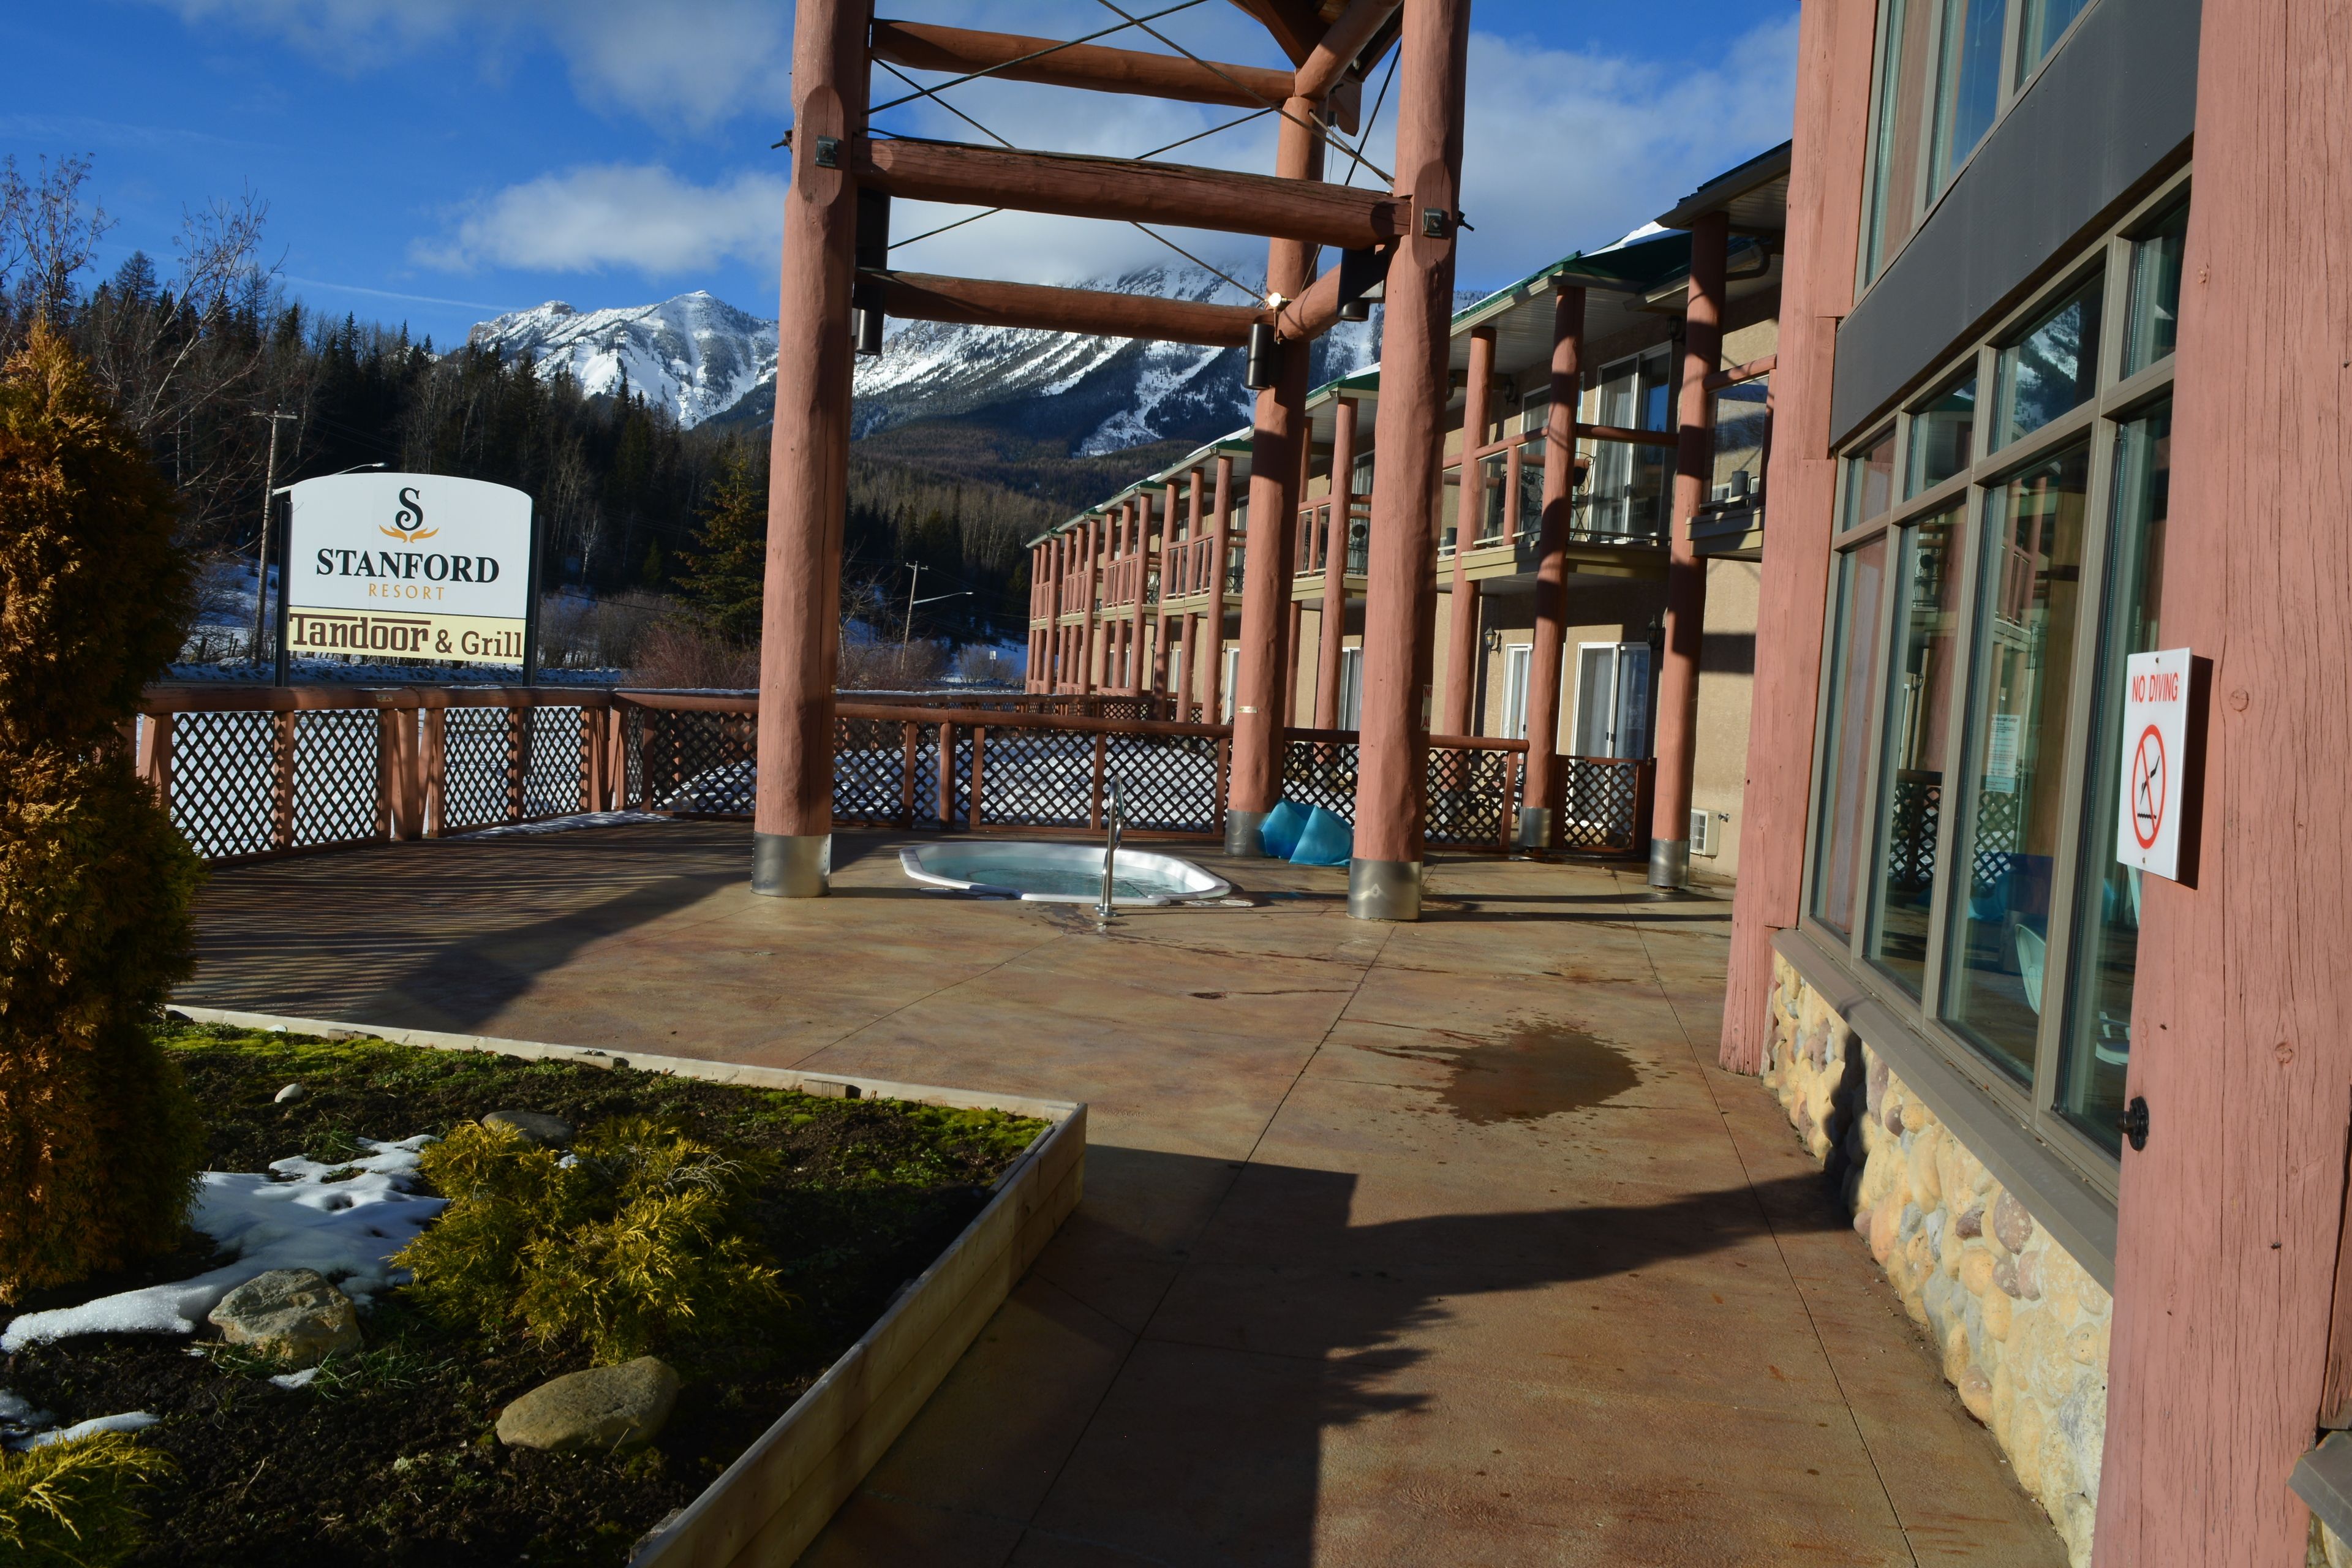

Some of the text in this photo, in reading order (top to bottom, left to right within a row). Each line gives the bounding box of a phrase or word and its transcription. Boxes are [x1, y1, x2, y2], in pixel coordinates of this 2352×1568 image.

[395, 487, 423, 531] S
[316, 548, 499, 583] STANFORD
[369, 583, 445, 600] RESORT
[289, 613, 522, 658] Tandoor & Grill
[2132, 672, 2178, 703] NO DIVING
